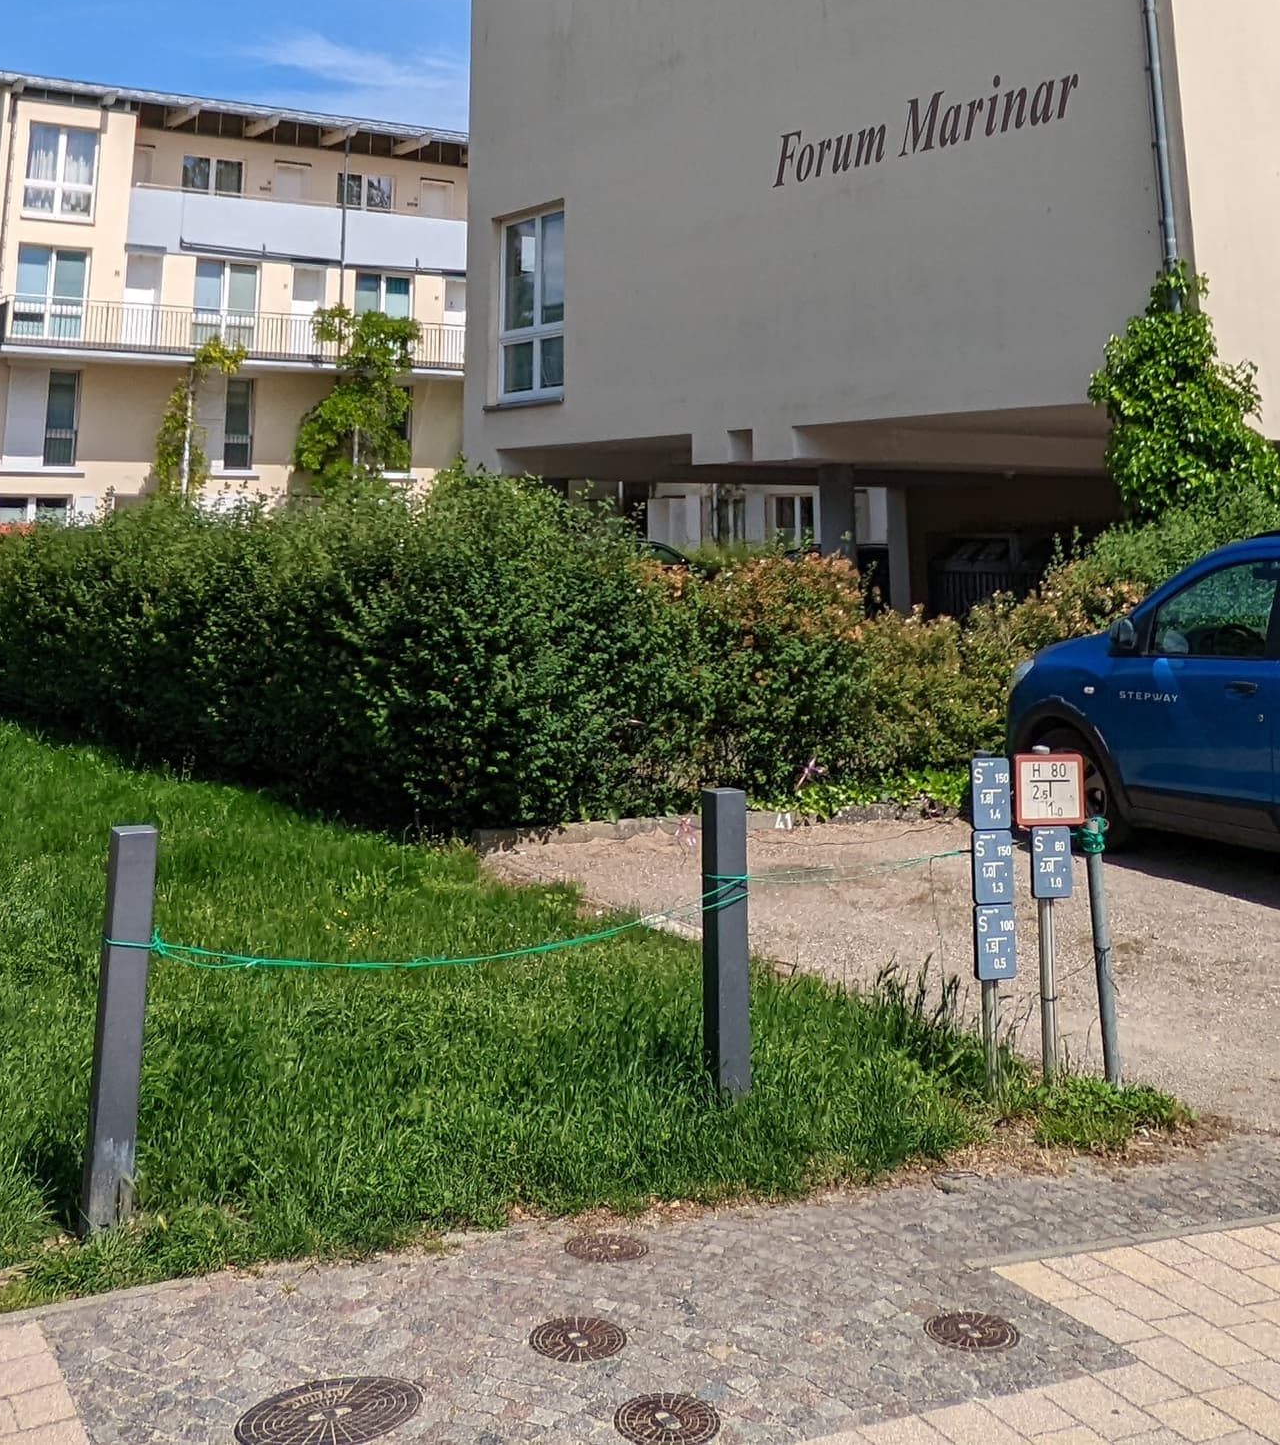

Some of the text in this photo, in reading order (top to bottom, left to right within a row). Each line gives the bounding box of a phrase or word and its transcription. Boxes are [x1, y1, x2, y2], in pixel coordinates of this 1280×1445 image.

[772, 73, 1080, 188] Forum Marinar
[1119, 690, 1178, 703] STEPWAY
[974, 768, 1009, 784] S 150
[1032, 763, 1067, 778] H 80
[975, 840, 1011, 857] S 150
[1035, 836, 1044, 852] S
[979, 916, 1014, 932] S 100
